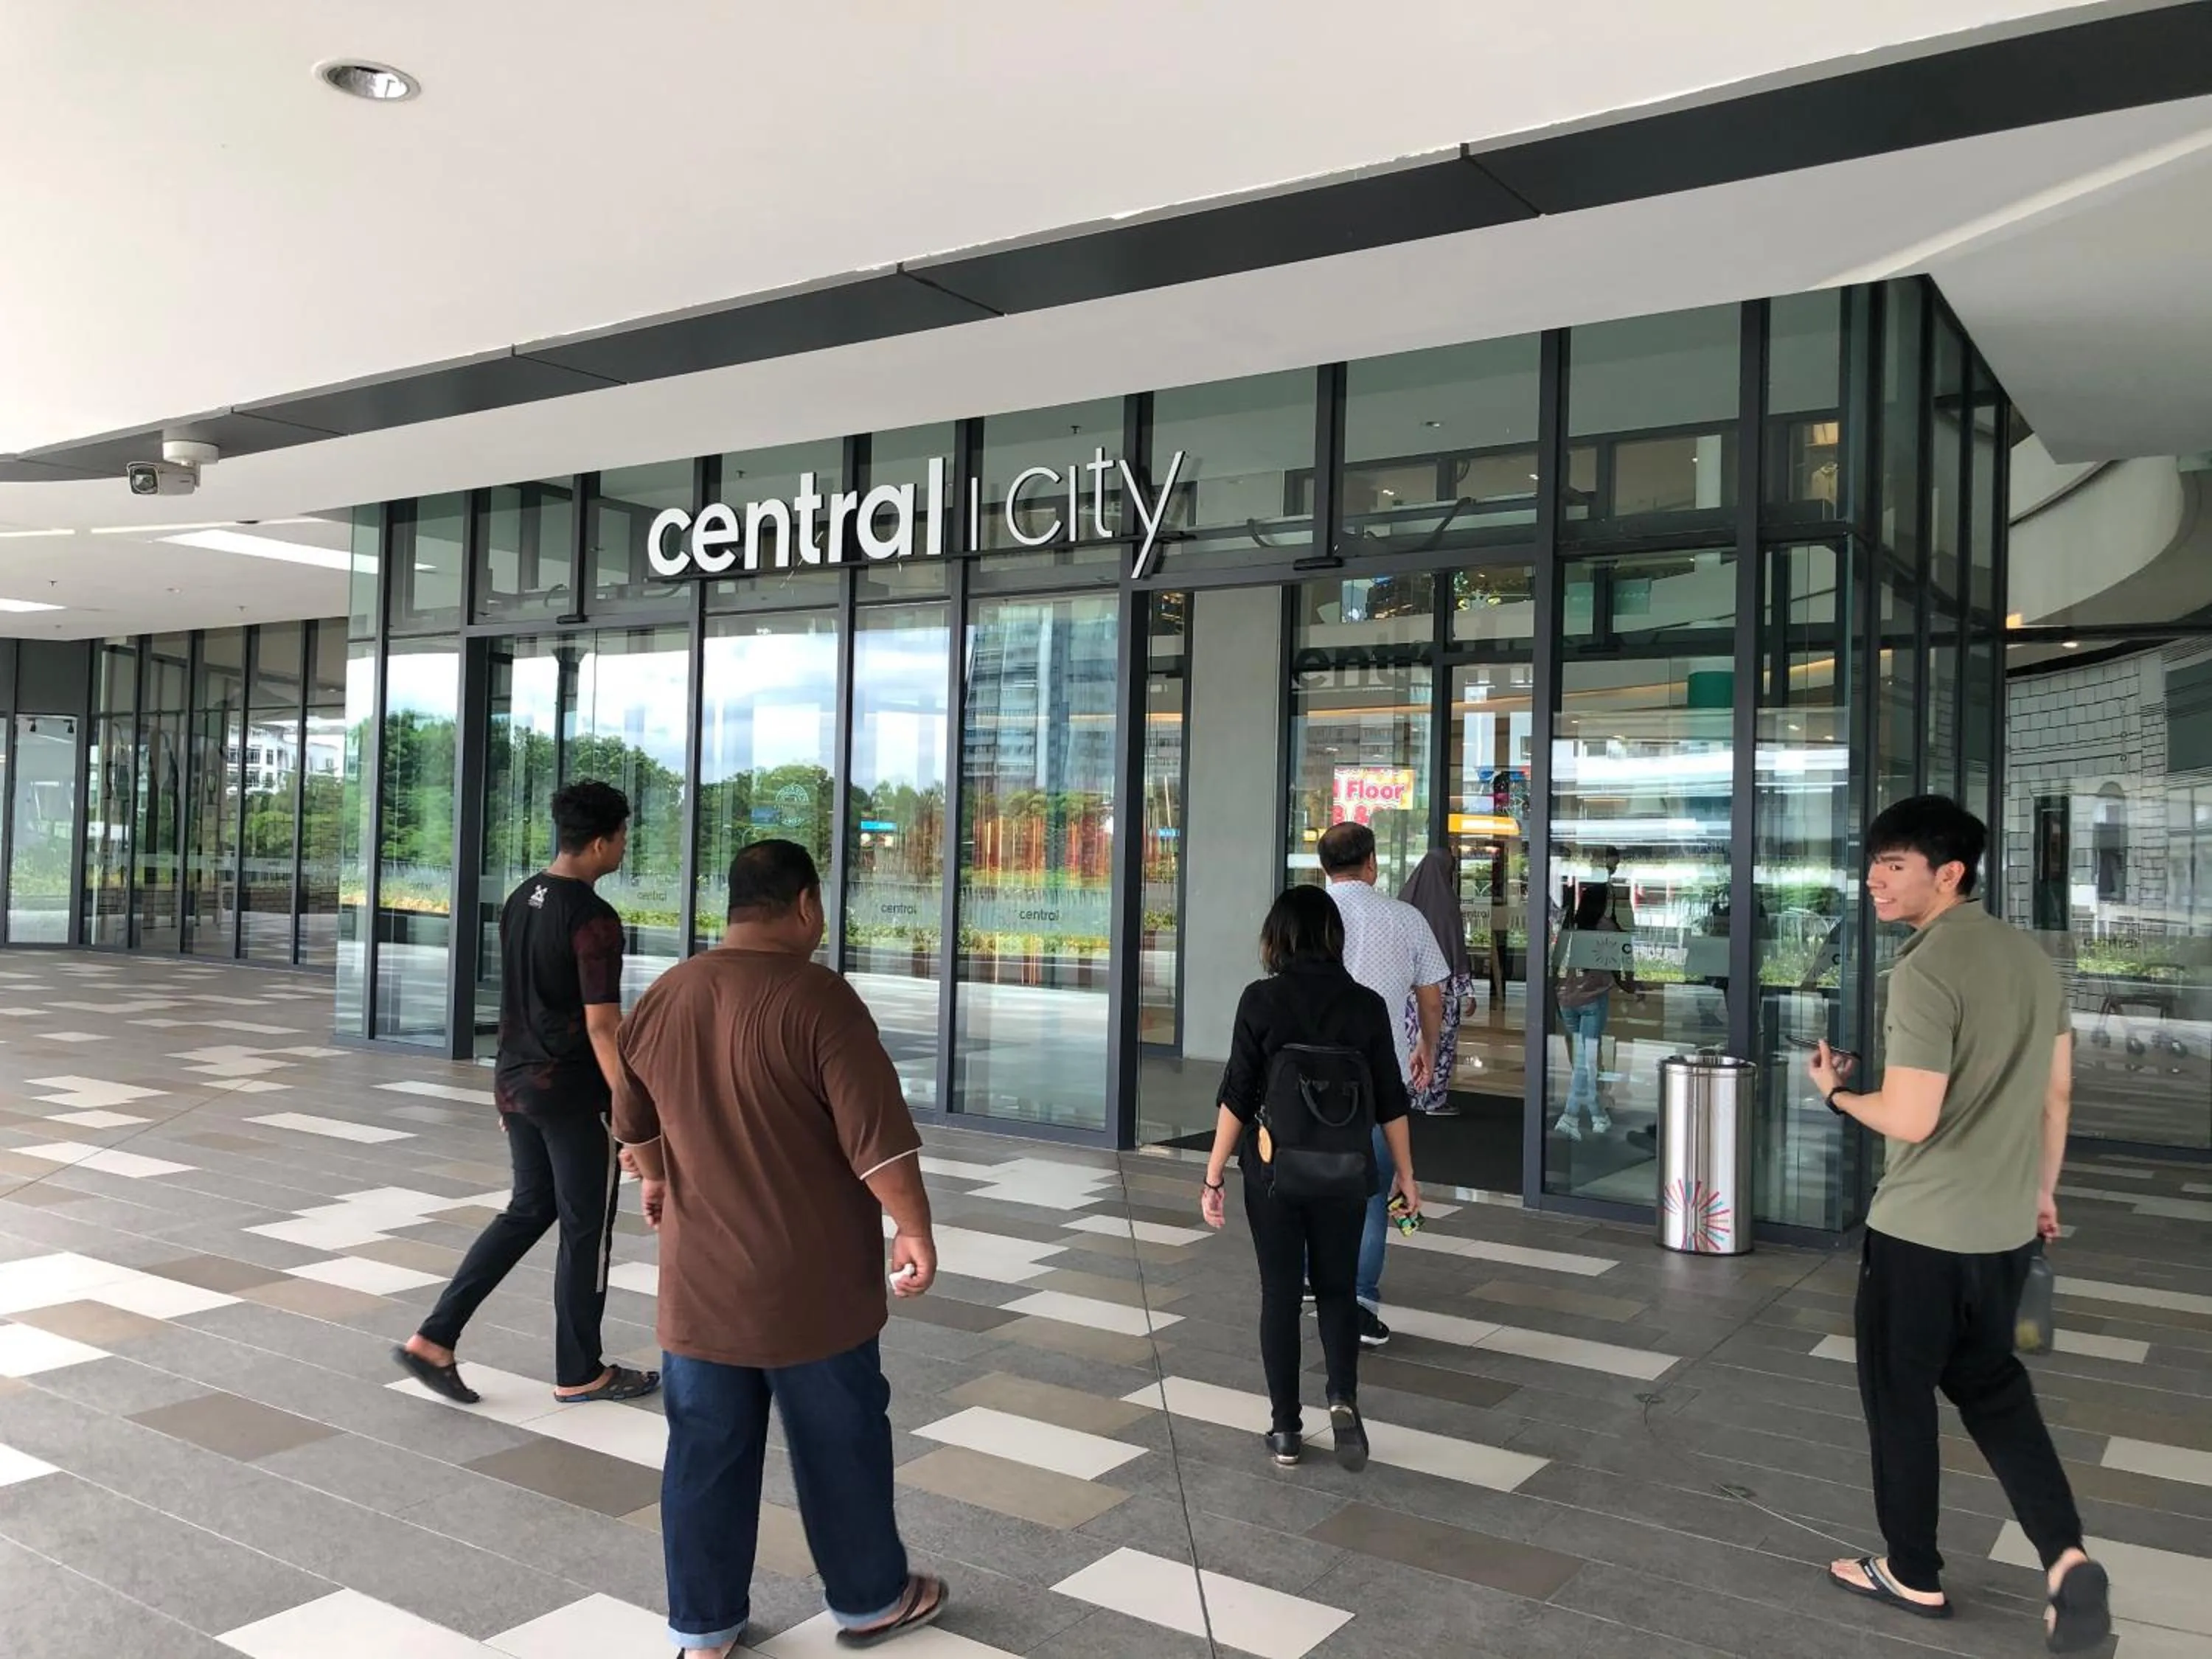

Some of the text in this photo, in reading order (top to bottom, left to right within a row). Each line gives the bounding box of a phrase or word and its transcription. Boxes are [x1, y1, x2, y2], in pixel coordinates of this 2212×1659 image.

[647, 447, 1186, 580] central city
[1346, 778, 1404, 799] Floor
[880, 902, 917, 914] central
[1019, 908, 1060, 921] central
